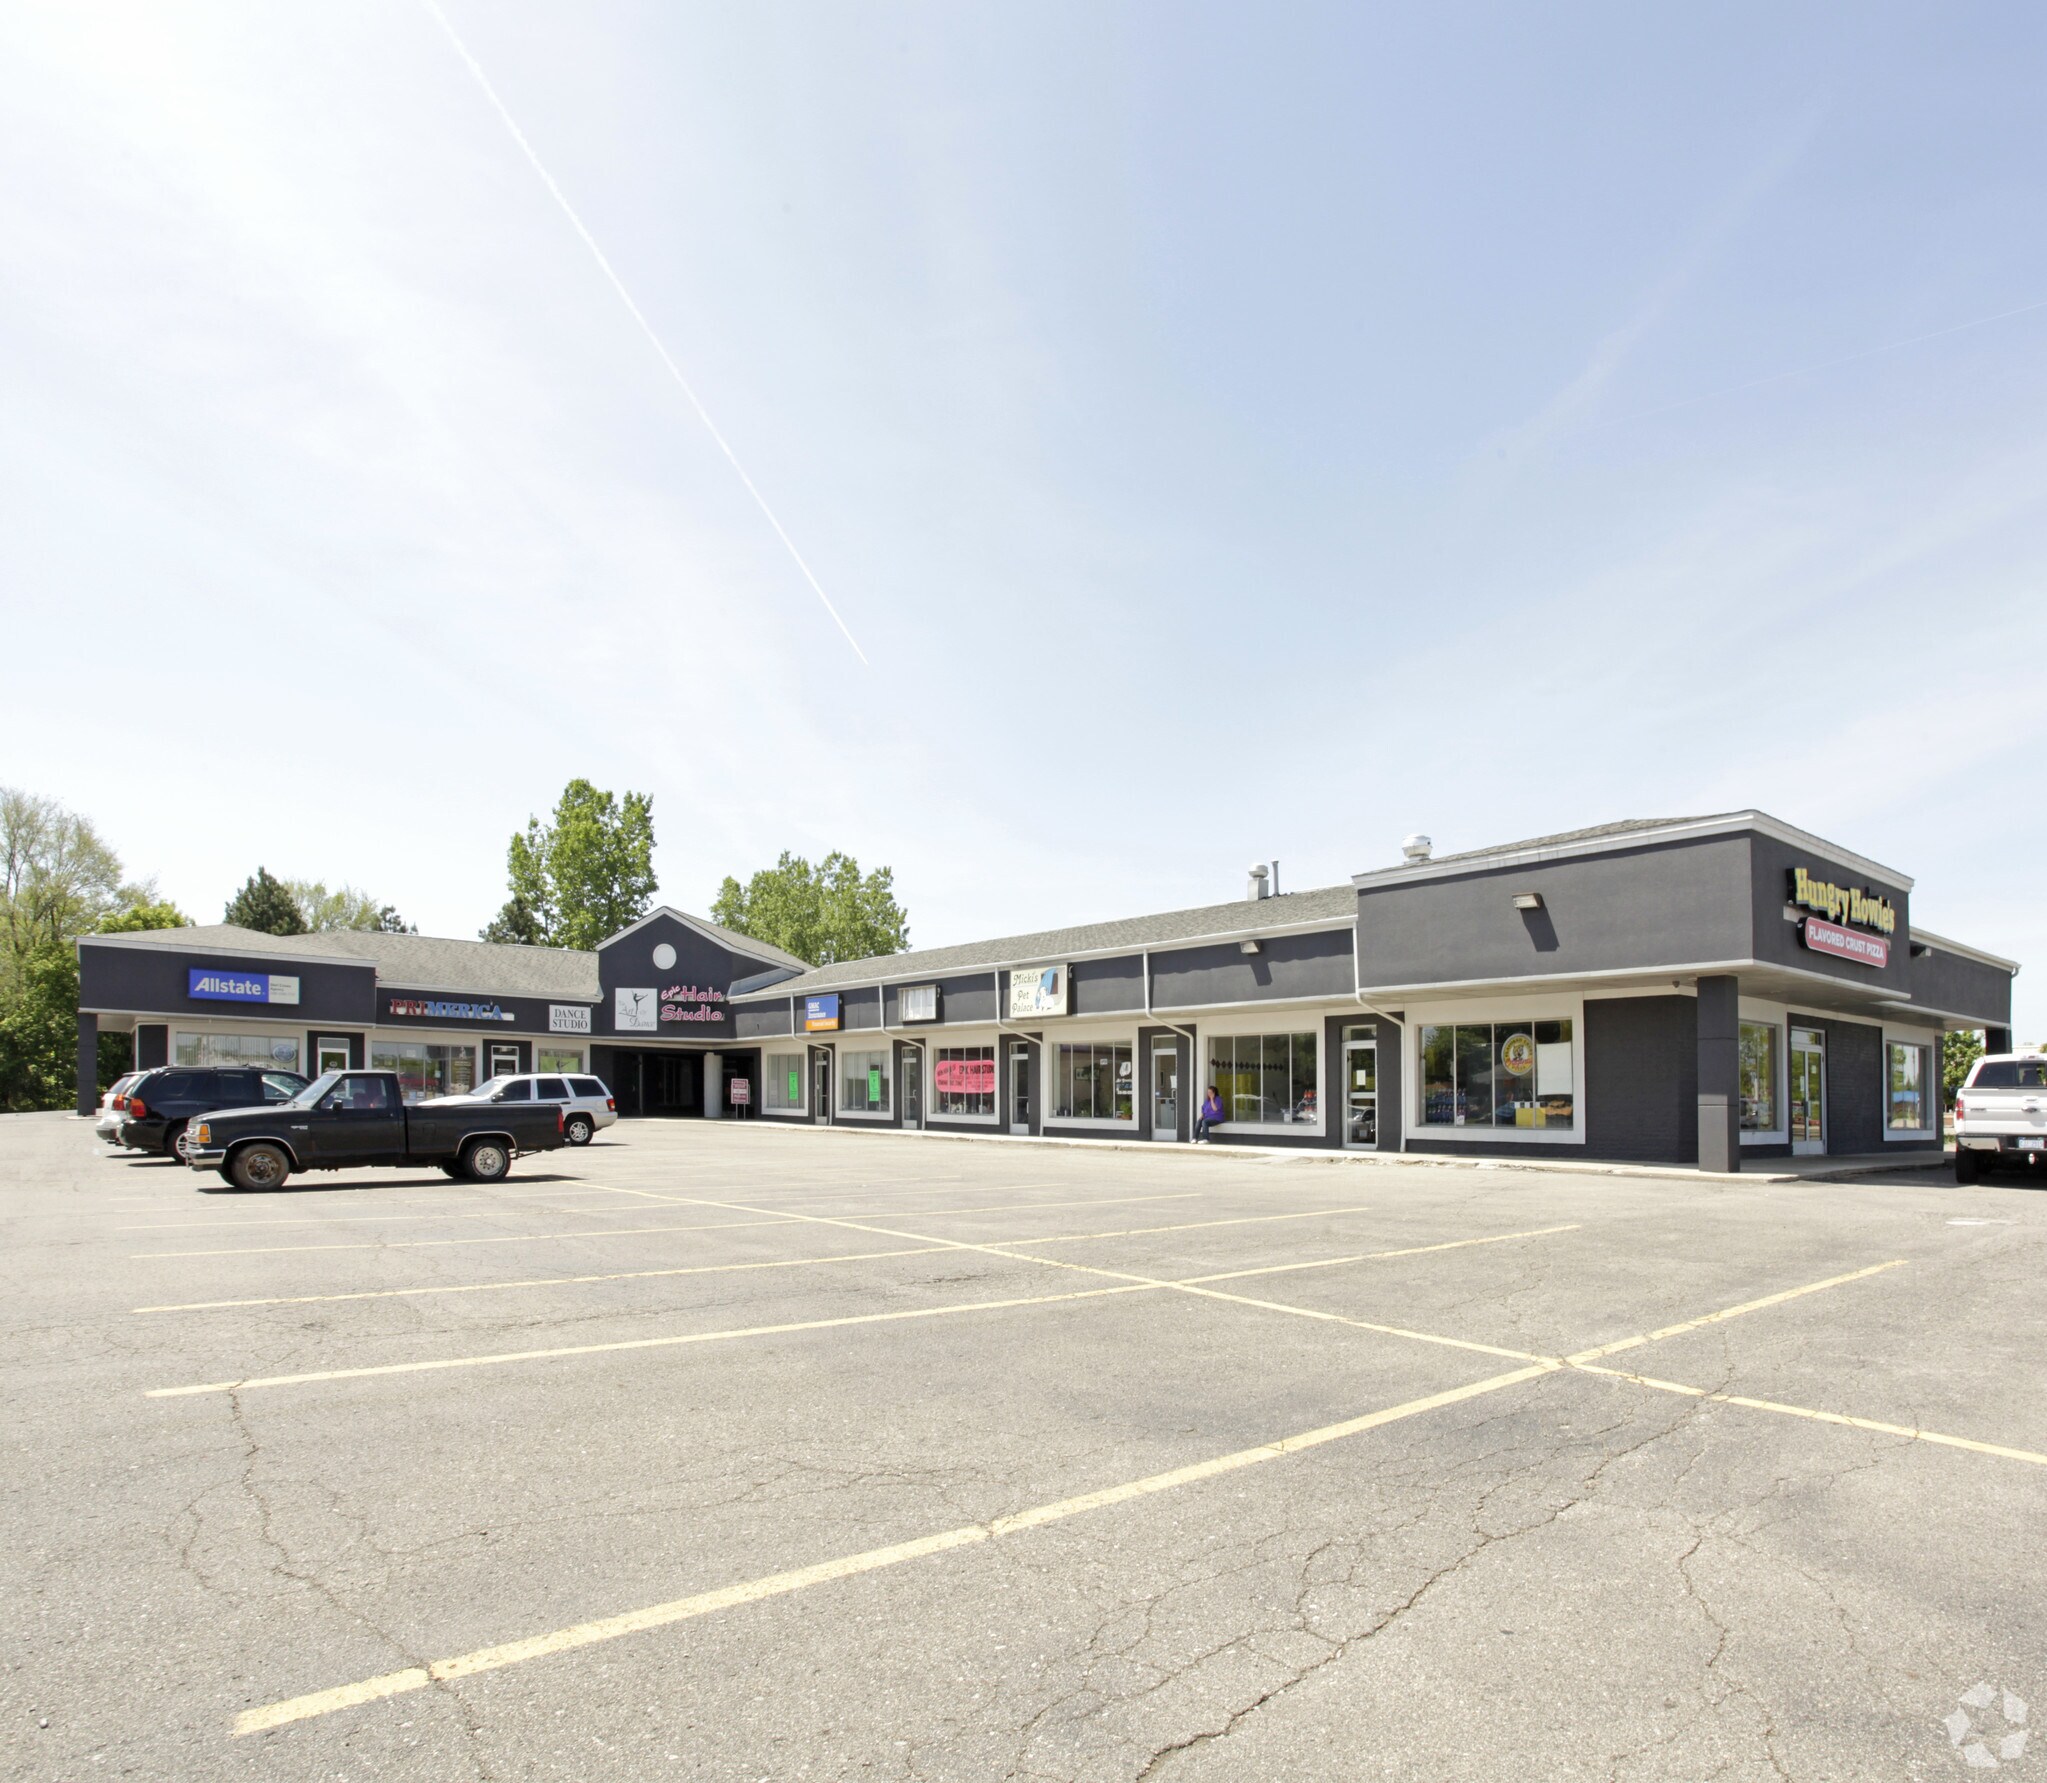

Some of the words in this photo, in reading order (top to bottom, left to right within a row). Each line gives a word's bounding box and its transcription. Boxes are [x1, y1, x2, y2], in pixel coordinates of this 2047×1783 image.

[1794, 867, 1850, 927] Hungry
[1849, 887, 1895, 934] Howie's
[1808, 925, 1845, 948] FLAVORED
[1845, 936, 1866, 953] CRUST
[1867, 943, 1885, 959] PIZZA
[194, 977, 262, 995] Allstate
[660, 984, 681, 1001] Epic
[681, 985, 723, 1002] Hair
[1017, 990, 1030, 1001] Pet
[390, 998, 504, 1021] PRIMERICA
[554, 1008, 586, 1019] DANCE
[660, 1003, 723, 1022] Studio
[1012, 1002, 1033, 1014] Palace
[552, 1019, 588, 1030] STUDIO
